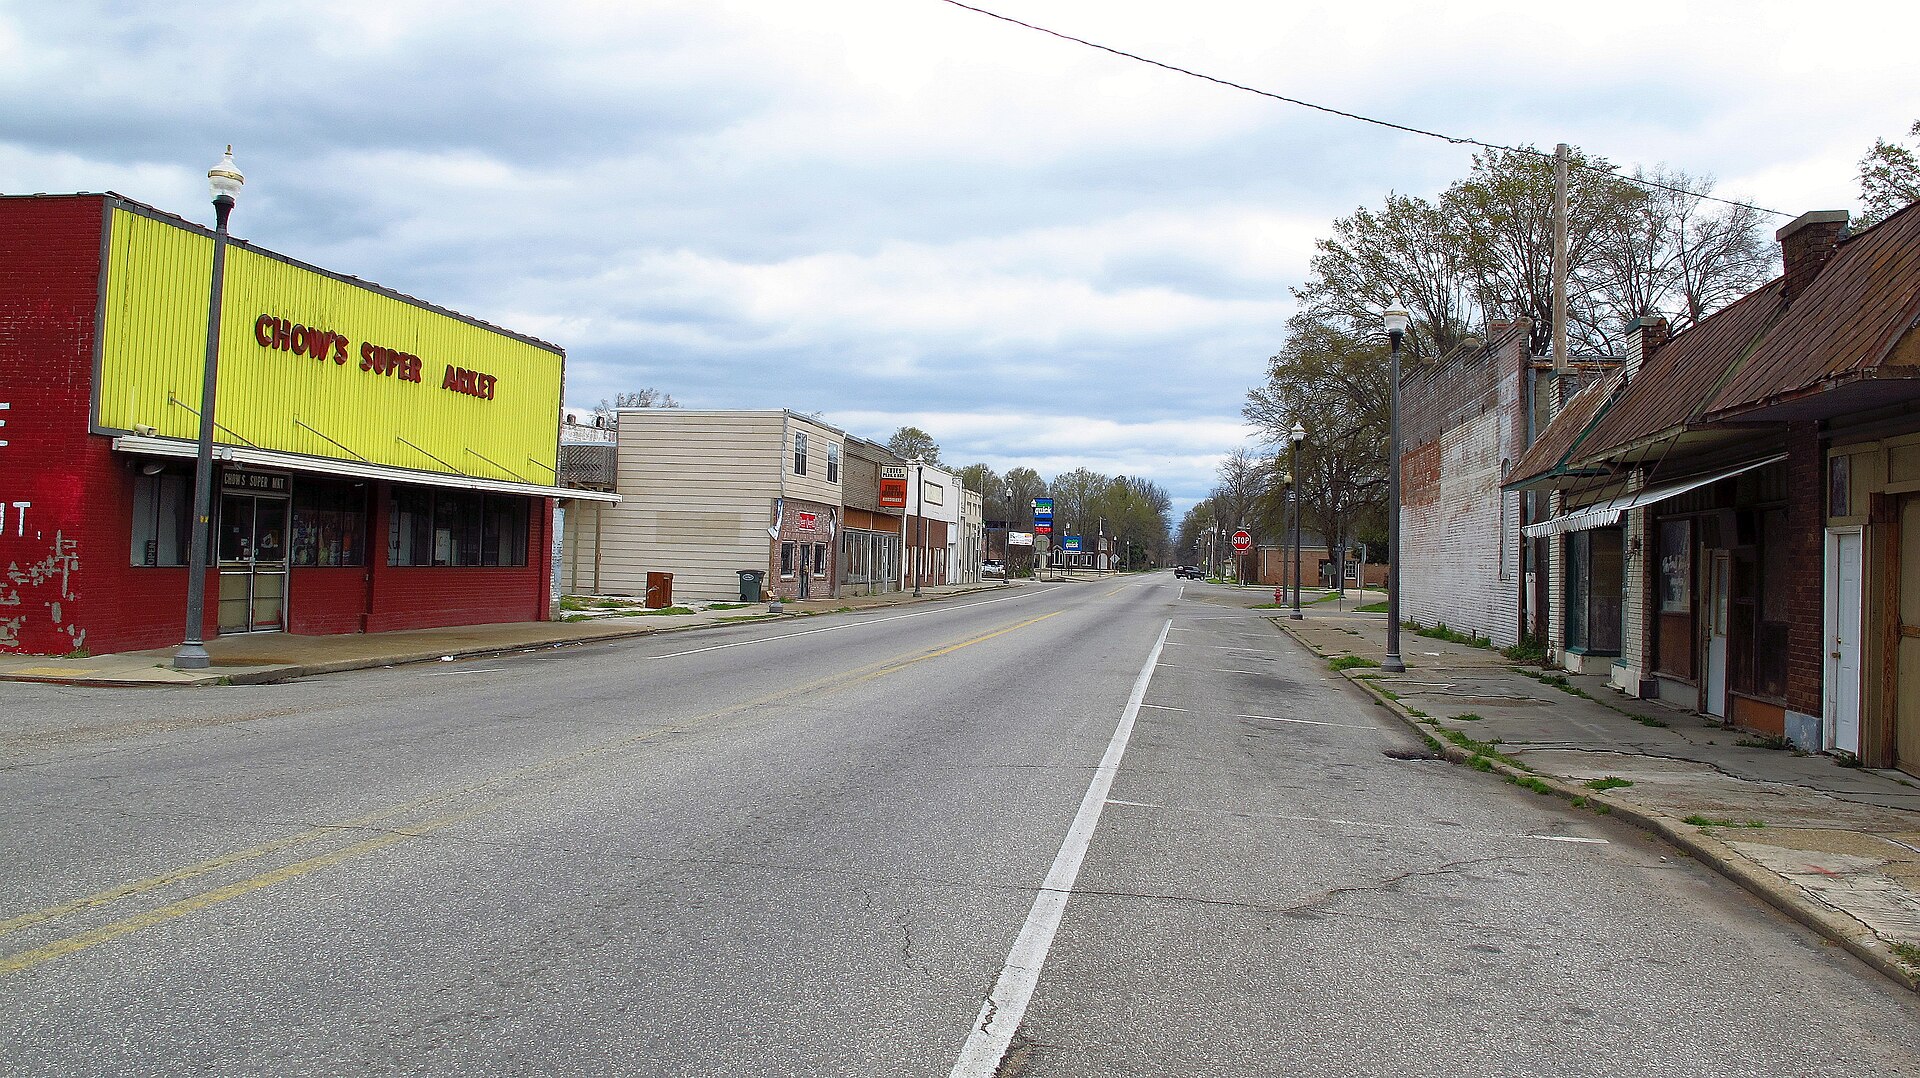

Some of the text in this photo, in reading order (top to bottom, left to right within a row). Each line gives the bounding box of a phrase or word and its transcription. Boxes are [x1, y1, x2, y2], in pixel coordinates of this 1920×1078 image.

[255, 313, 498, 400] CHOW'S SUPER ARKET
[249, 475, 268, 488] SUPER
[1034, 506, 1053, 516] quick
[1233, 536, 1250, 545] STOP
